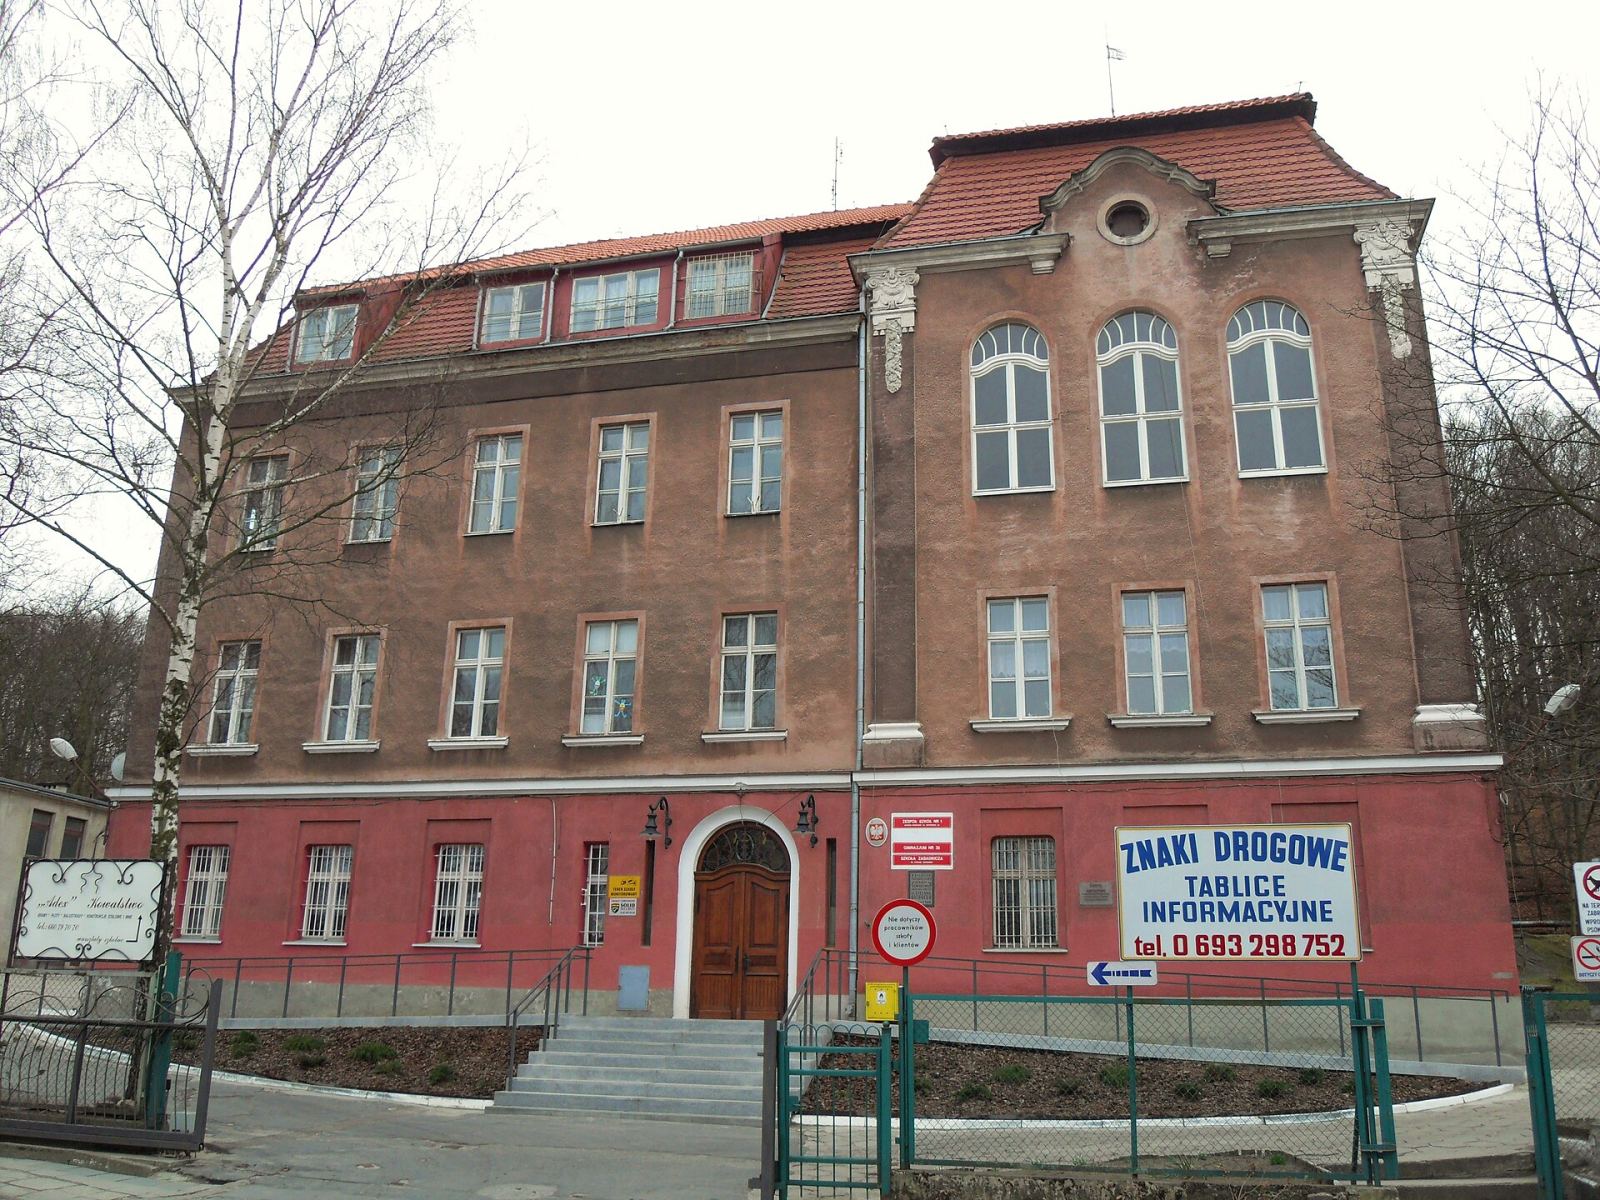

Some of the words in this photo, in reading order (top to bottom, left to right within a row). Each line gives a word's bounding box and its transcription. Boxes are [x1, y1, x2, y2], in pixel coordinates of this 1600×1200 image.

[1120, 833, 1198, 874] ZNAKI
[1214, 831, 1348, 872] DROGOWE
[1184, 875, 1286, 897] TABLICE
[87, 896, 143, 910] Kowalstwo
[1143, 900, 1334, 922] INFORMACYJNE
[1134, 935, 1166, 957] tel.
[1173, 934, 1188, 957] 0
[1196, 934, 1242, 957] 693
[1249, 934, 1296, 957] 298
[1302, 934, 1346, 957] 752
